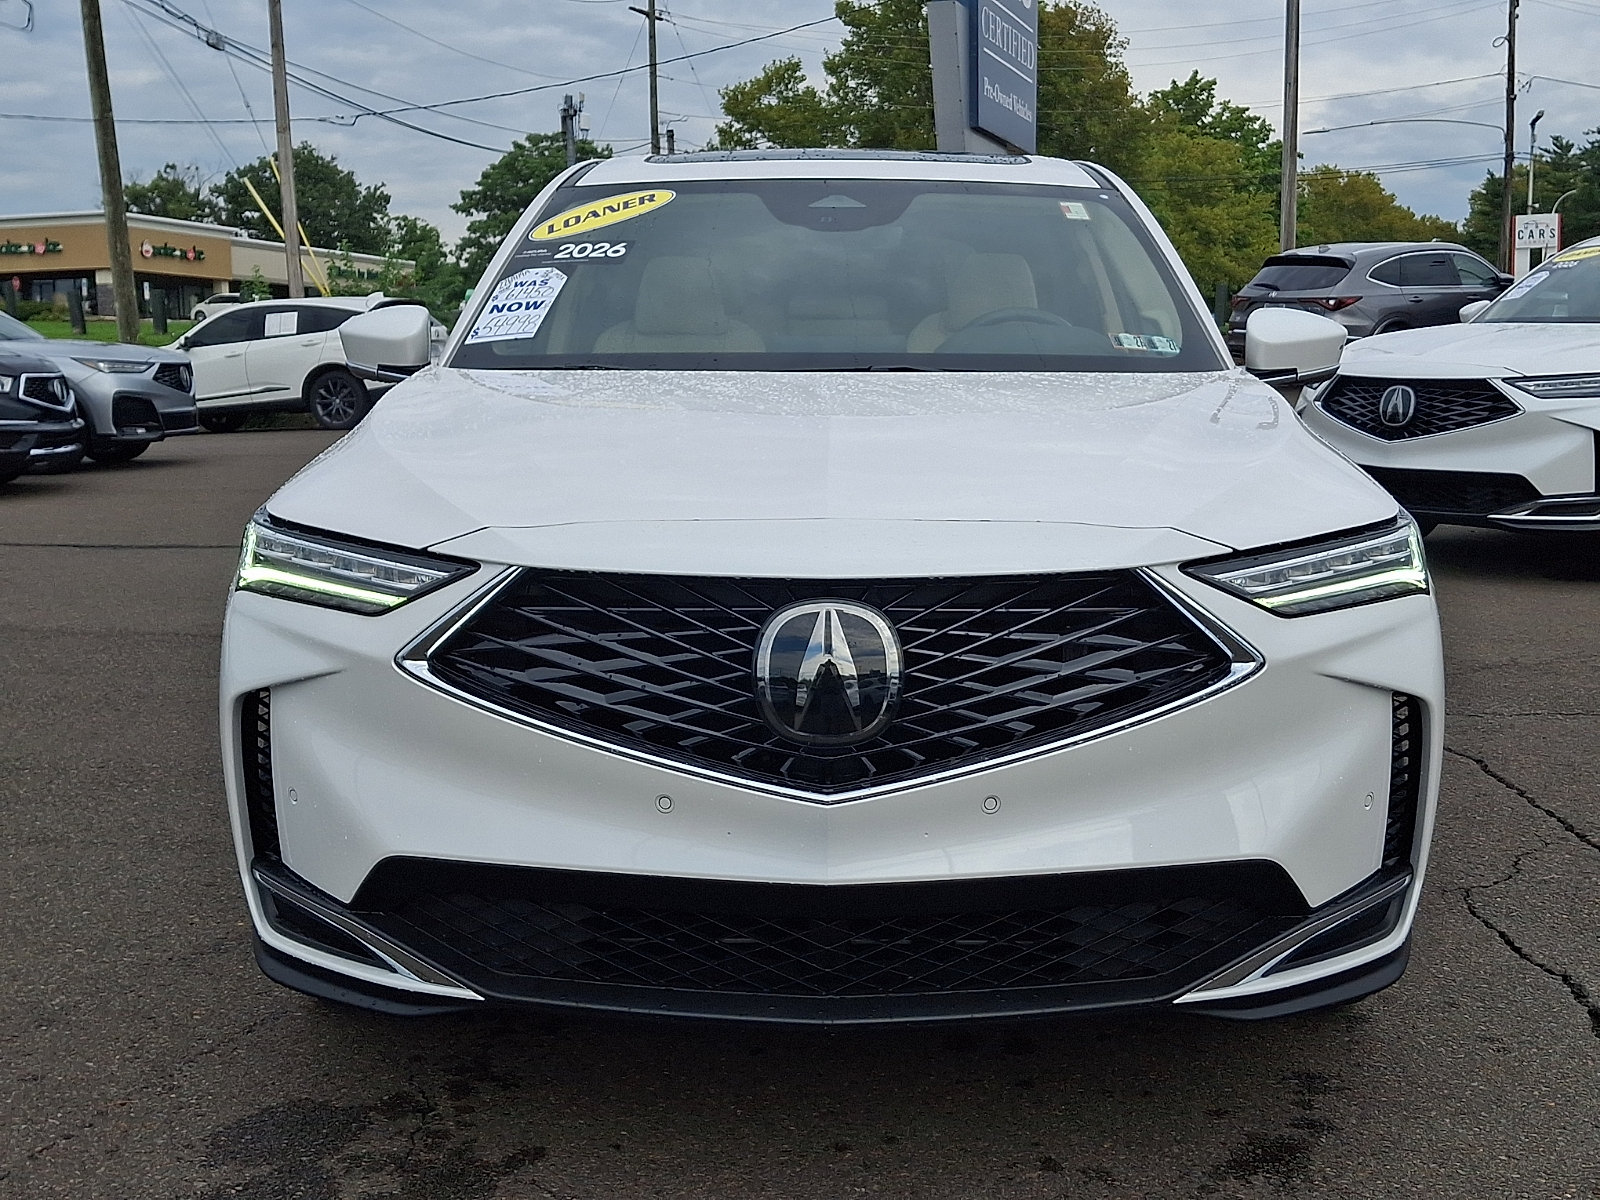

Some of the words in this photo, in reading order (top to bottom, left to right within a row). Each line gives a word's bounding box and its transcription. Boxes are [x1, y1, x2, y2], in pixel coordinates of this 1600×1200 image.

[982, 6, 1034, 70] CERTIFIED
[983, 76, 1013, 111] Pre-Owned
[1013, 95, 1032, 122] Vehicles
[547, 193, 657, 235] LOANER
[1517, 228, 1556, 240] CARS
[553, 243, 628, 259] 2026
[513, 278, 549, 288] WAS
[489, 301, 546, 314] NOW
